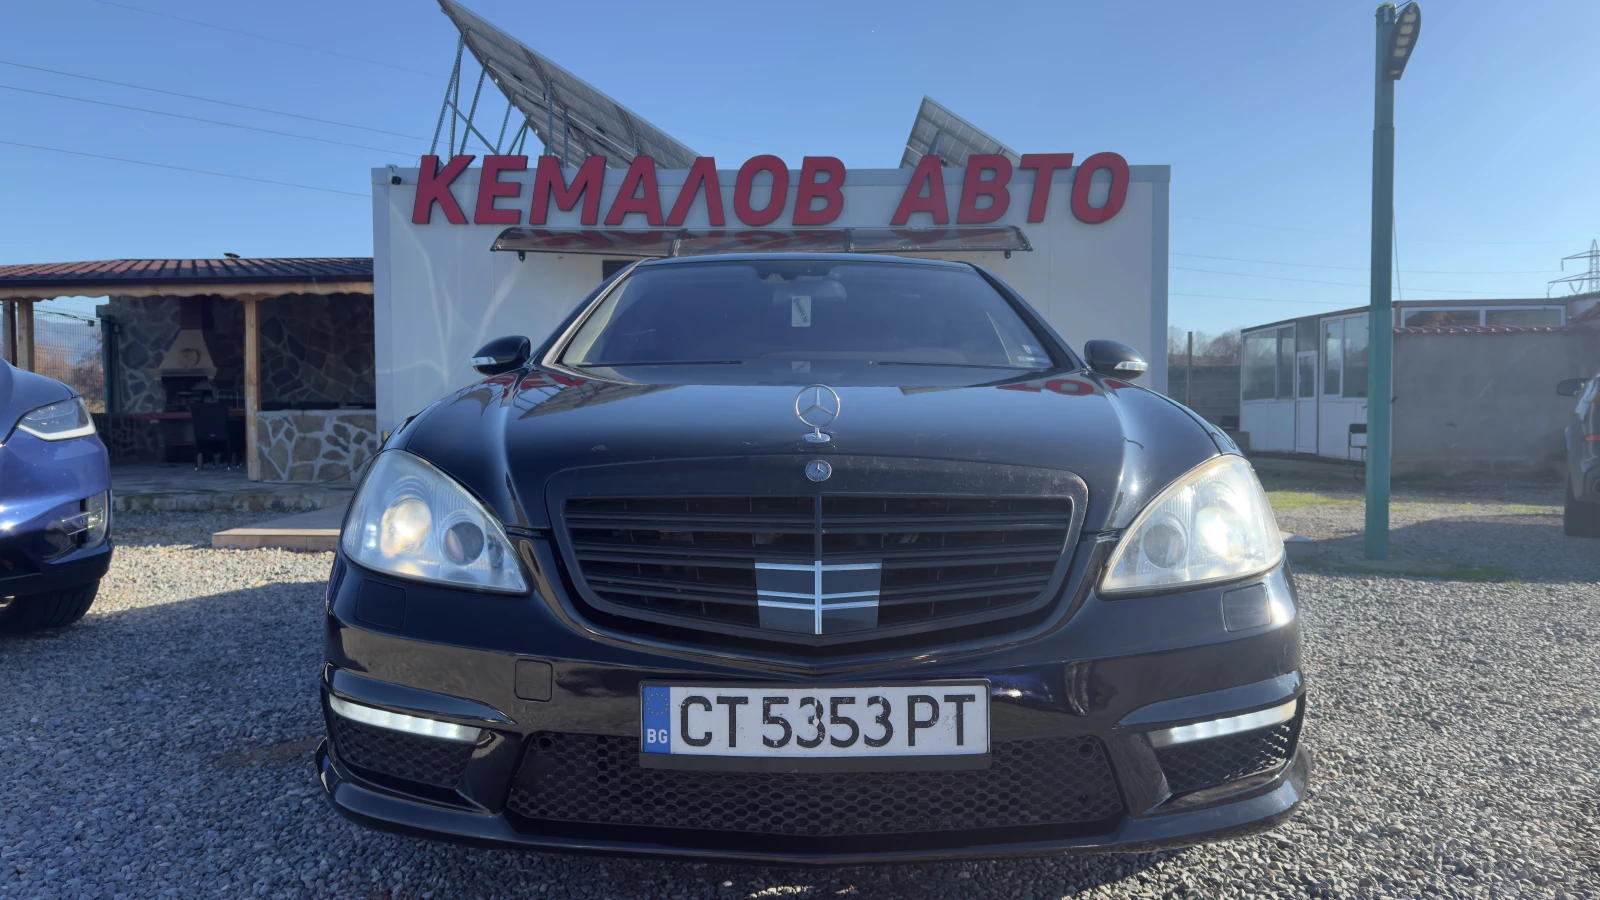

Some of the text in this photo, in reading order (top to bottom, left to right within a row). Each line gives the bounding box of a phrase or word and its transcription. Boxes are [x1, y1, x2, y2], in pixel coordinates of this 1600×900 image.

[412, 151, 1131, 227] КЕМАЛОВ АВТО
[647, 728, 669, 744] BG
[680, 694, 976, 748] CT 5353 PT
